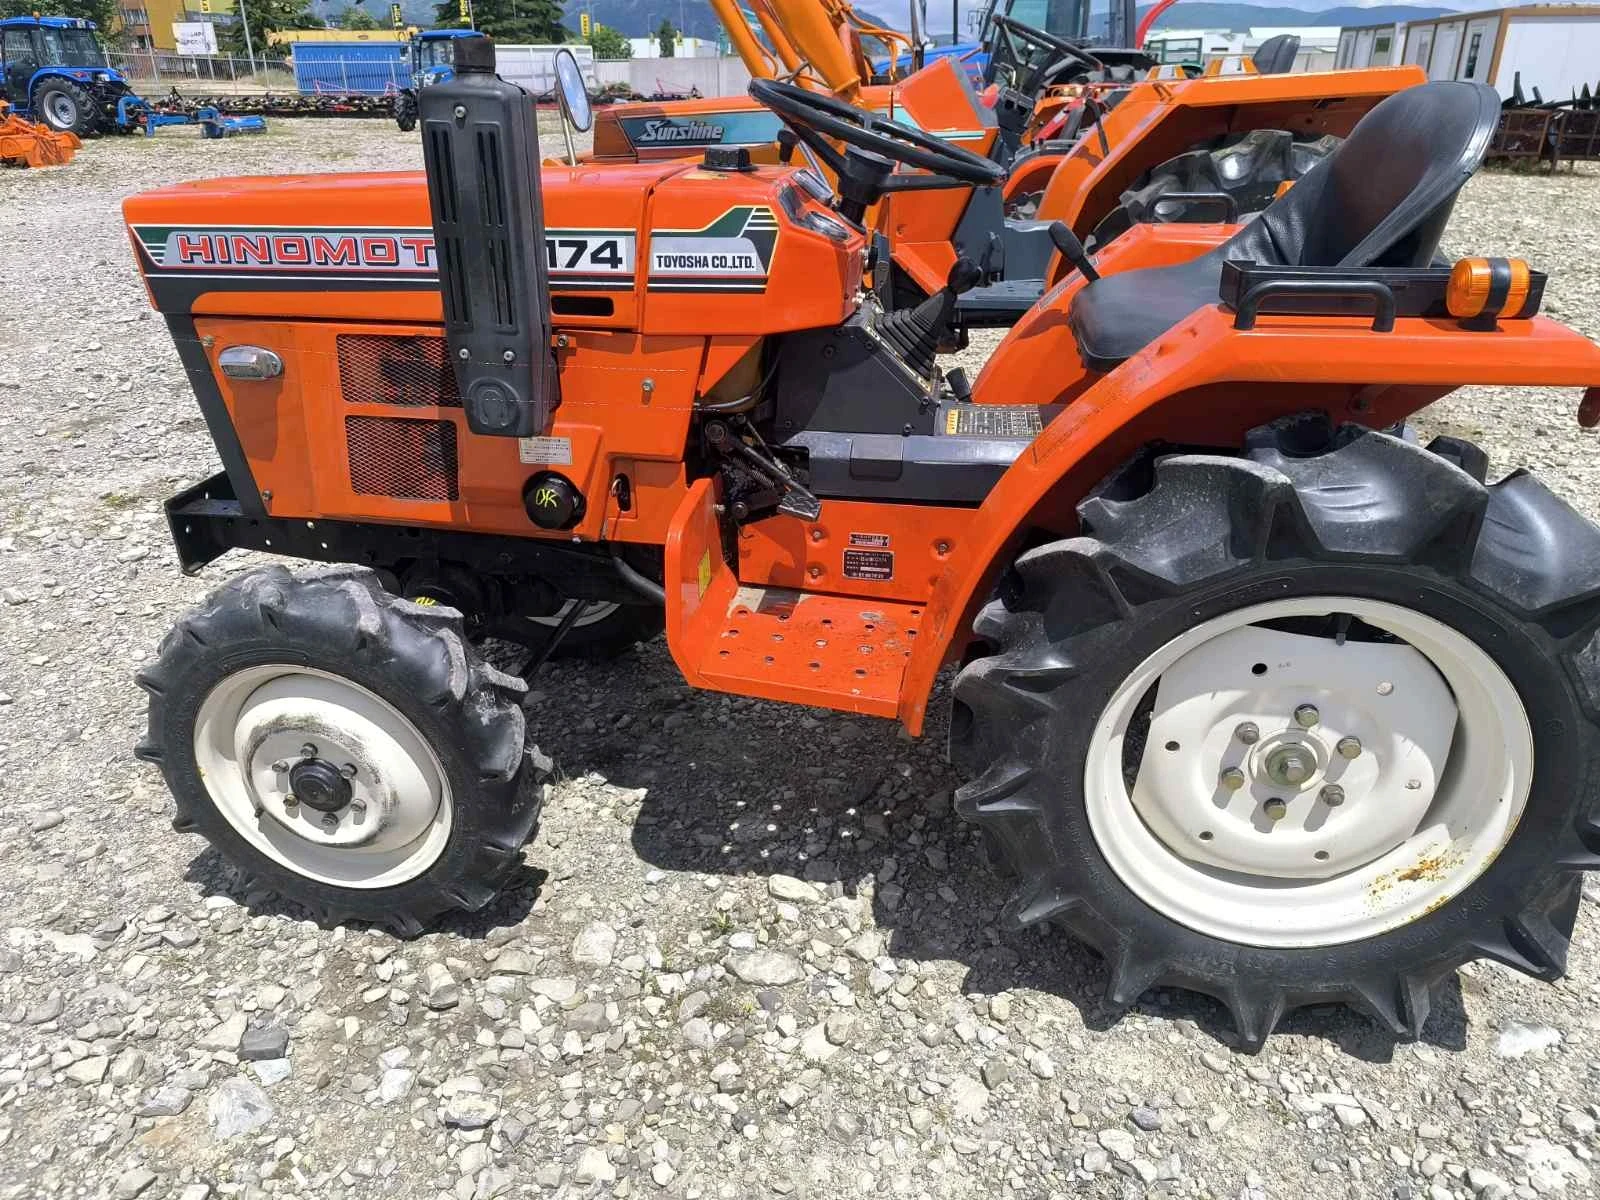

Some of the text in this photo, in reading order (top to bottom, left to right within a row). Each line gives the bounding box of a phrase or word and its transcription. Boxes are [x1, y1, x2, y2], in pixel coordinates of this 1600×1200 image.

[637, 120, 723, 141] Sunshine
[176, 235, 436, 266] HINOMOT
[545, 239, 623, 269] 174
[656, 255, 709, 268] TOYOSHA
[535, 488, 558, 508] OK
